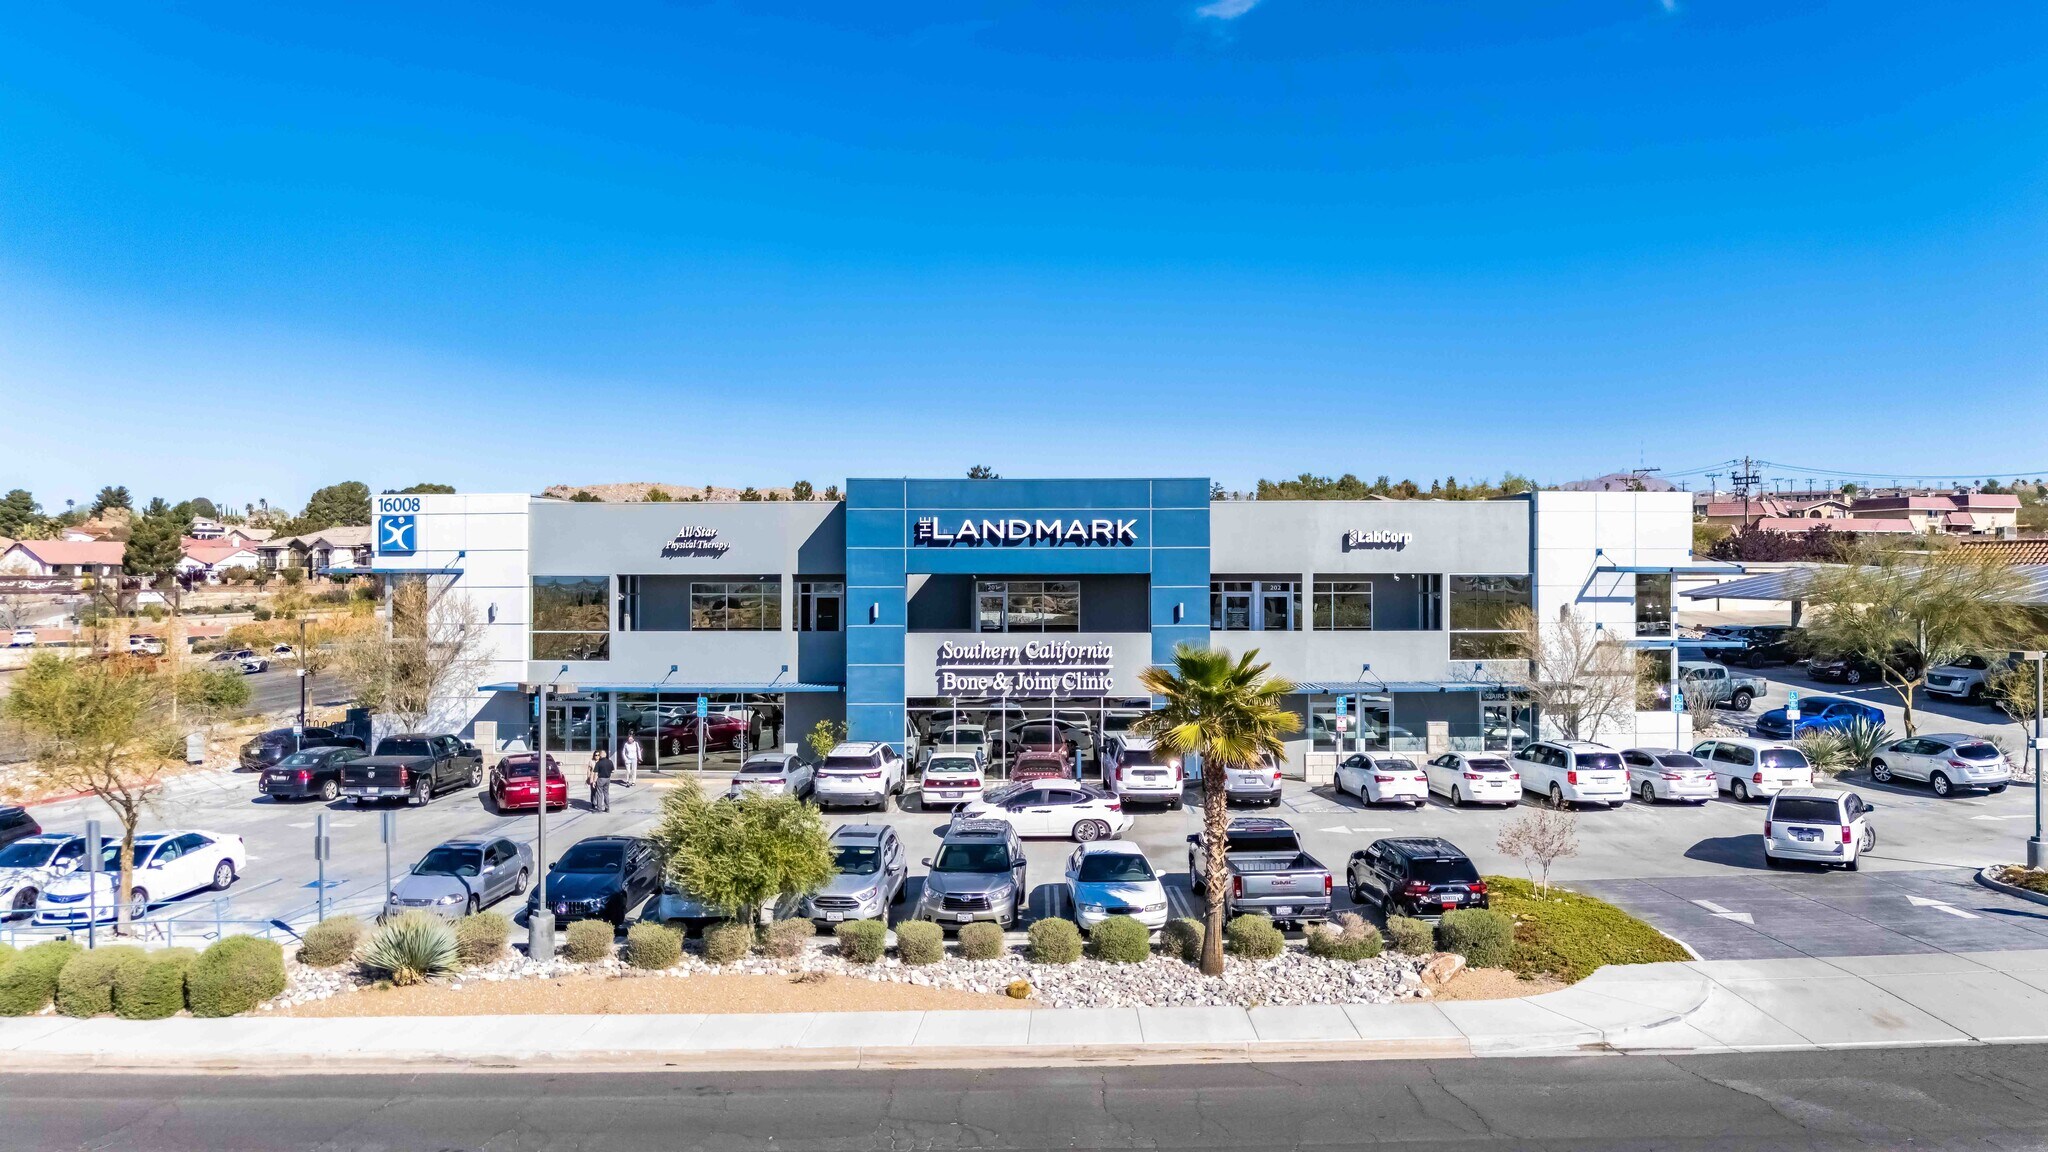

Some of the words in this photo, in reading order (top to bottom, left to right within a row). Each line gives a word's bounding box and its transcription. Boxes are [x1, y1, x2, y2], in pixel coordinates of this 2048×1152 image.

[378, 497, 420, 512] 16008
[919, 516, 931, 539] THE
[932, 516, 1138, 539] LANDMARK
[666, 539, 697, 551] Physical
[697, 540, 728, 551] Therapy
[1357, 530, 1412, 545] LabCorp
[942, 641, 1020, 659] Southern
[1025, 640, 1114, 664] California
[942, 672, 988, 690] Bone
[992, 672, 1010, 690] &
[1016, 671, 1058, 691] Joint
[1061, 671, 1114, 691] Clinic
